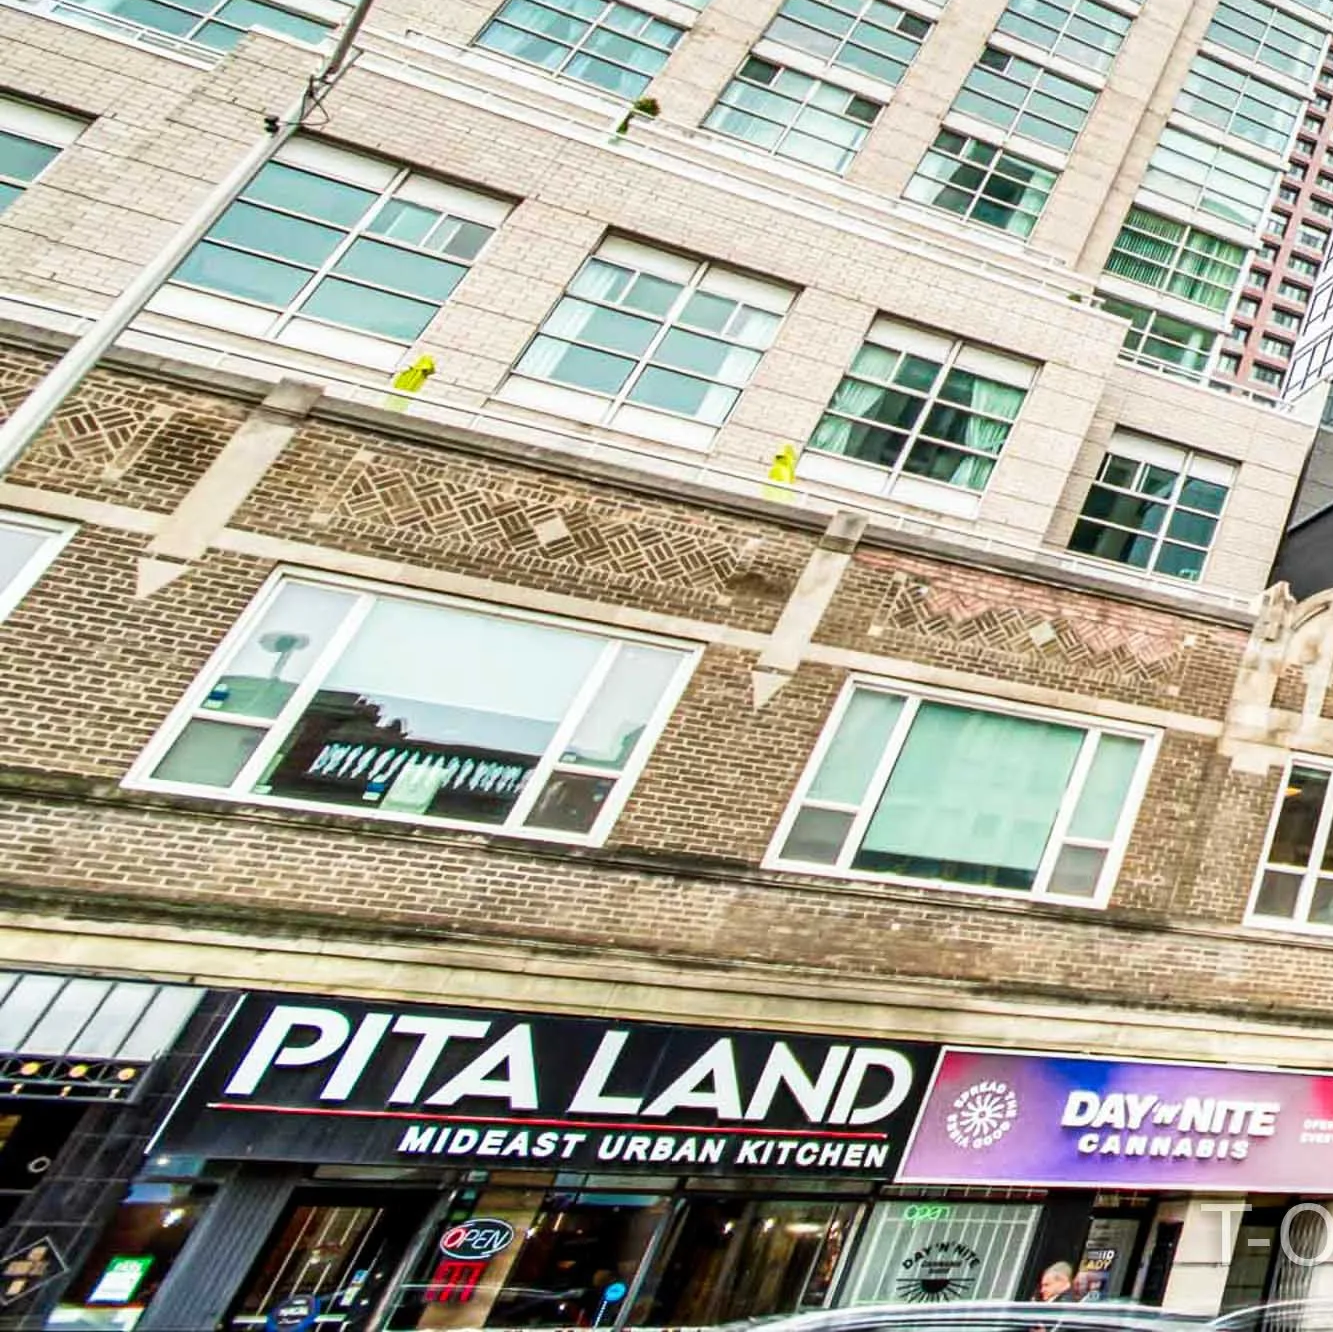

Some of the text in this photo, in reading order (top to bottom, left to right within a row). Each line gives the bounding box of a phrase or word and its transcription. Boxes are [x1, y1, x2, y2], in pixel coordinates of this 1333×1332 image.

[224, 1005, 914, 1126] PITA LAND
[1061, 1090, 1160, 1131] DAY
[1176, 1098, 1281, 1138] NITE
[397, 1125, 889, 1169] MIDEAST URBAN KITCHEN
[1078, 1134, 1250, 1161] CANNABIS
[442, 1227, 509, 1250] OPEN
